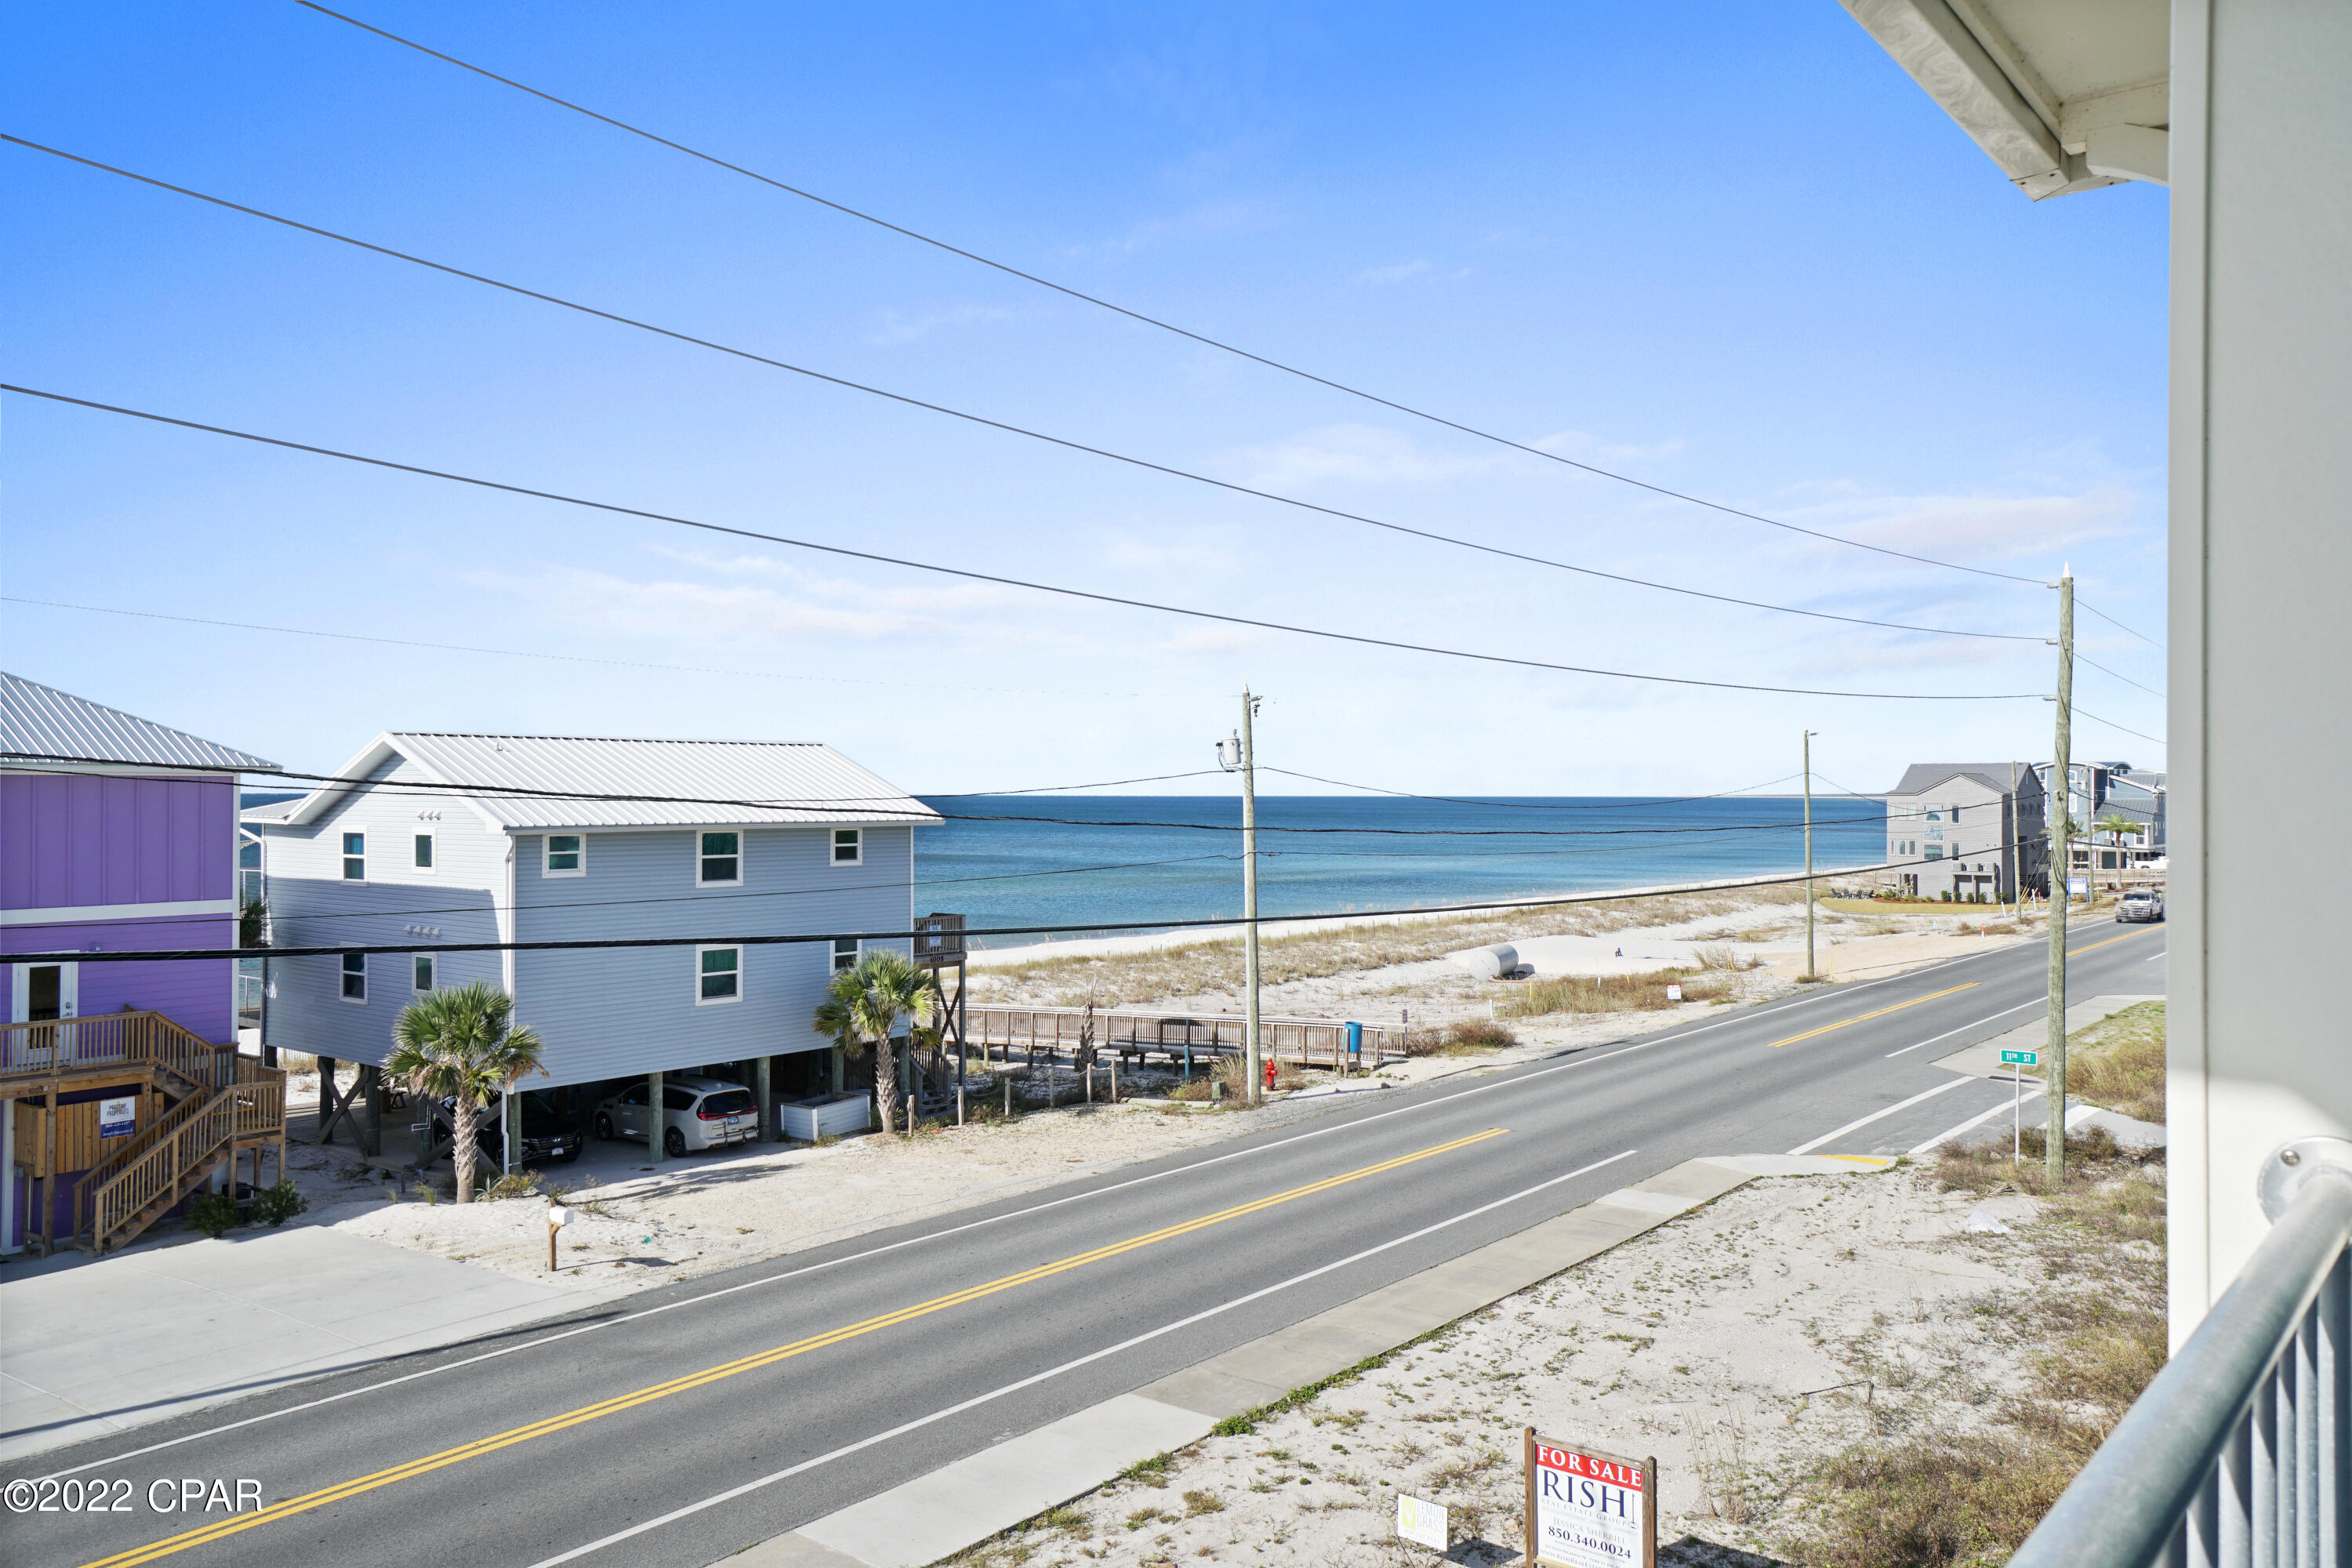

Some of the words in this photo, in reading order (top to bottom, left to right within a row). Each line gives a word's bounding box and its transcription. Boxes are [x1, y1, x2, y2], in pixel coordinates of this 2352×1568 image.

[2023, 1054, 2031, 1062] ST
[1537, 1445, 1583, 1472] FOR
[1589, 1459, 1642, 1487] SALE
[1542, 1469, 1628, 1518] RISH
[1417, 1501, 1444, 1519] LEMON
[1541, 1498, 1560, 1508] REAL
[1564, 1502, 1592, 1517] ESTATE
[1417, 1513, 1444, 1534] GRASS
[1554, 1517, 1584, 1533] JESSICA
[1548, 1526, 1632, 1559] 850.340.0024
